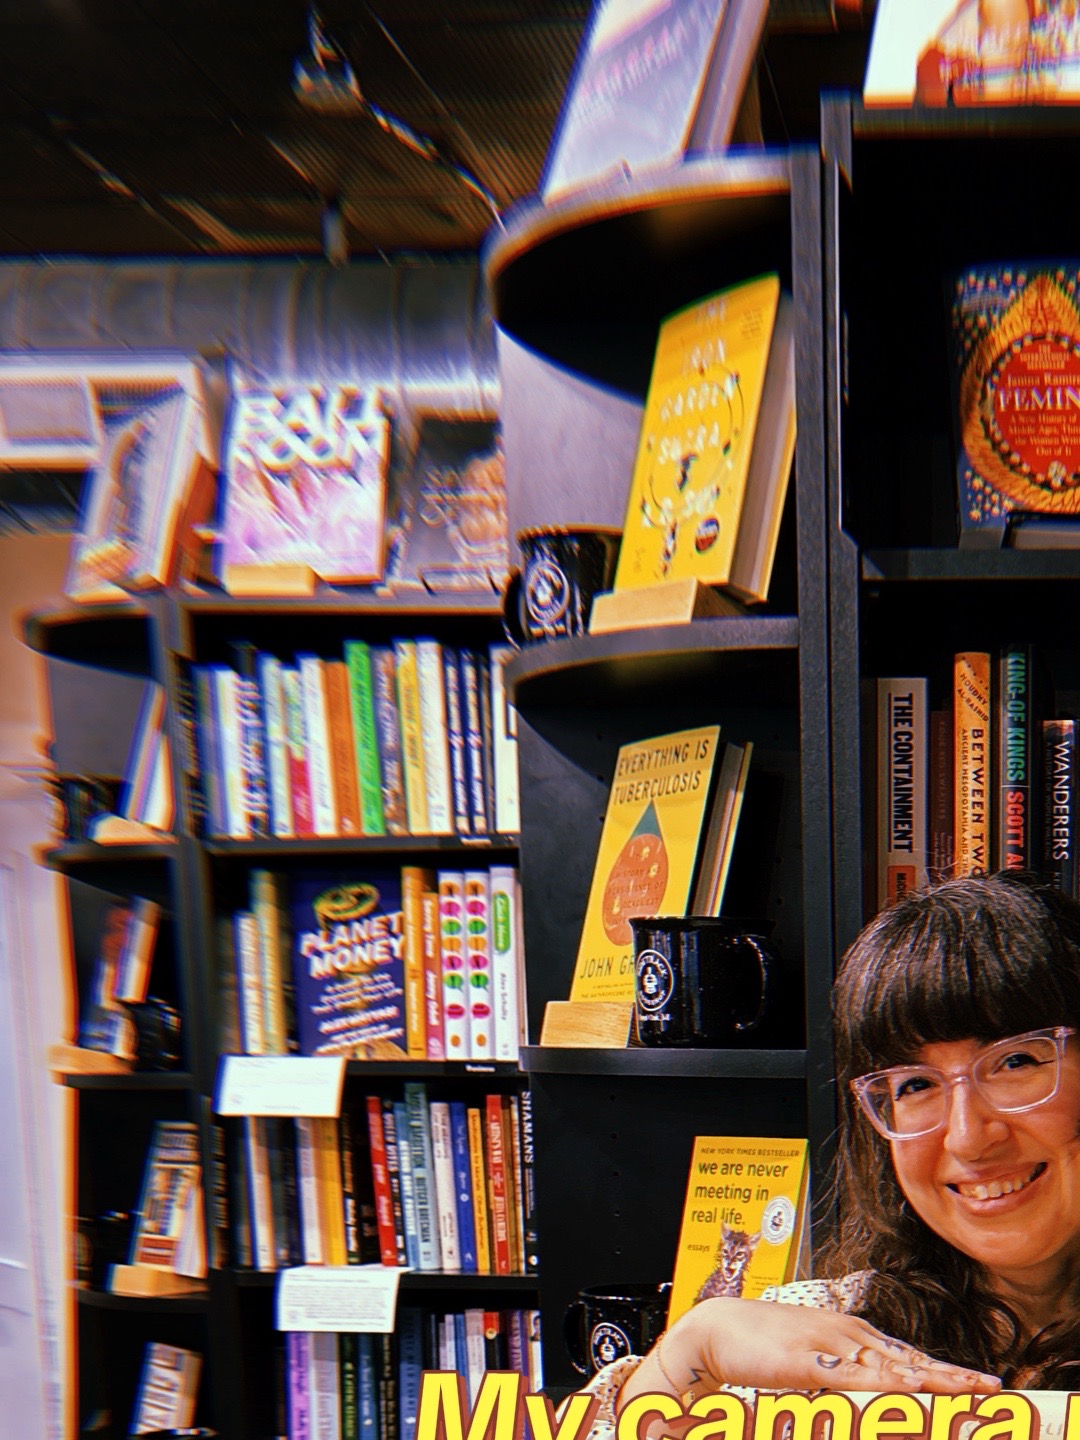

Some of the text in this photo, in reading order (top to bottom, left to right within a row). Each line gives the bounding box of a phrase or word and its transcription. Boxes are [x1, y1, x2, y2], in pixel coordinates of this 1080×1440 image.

[1007, 374, 1040, 386] Janina
[617, 738, 709, 777] EVERYTHING IS
[893, 693, 913, 853] THE CONTAINMENT
[613, 770, 702, 806] TUBERCULOSIS
[971, 729, 985, 876] BETWEEN TWO
[1052, 741, 1070, 860] WANDERERS
[300, 910, 404, 957] PLANET
[309, 935, 405, 979] MONEY
[580, 958, 613, 979] JOHN
[521, 1091, 534, 1164] SHAMANS
[698, 1161, 789, 1178] we are never
[694, 1184, 769, 1204] meeting in
[691, 1208, 746, 1225] real life.
[687, 1243, 710, 1252] essays
